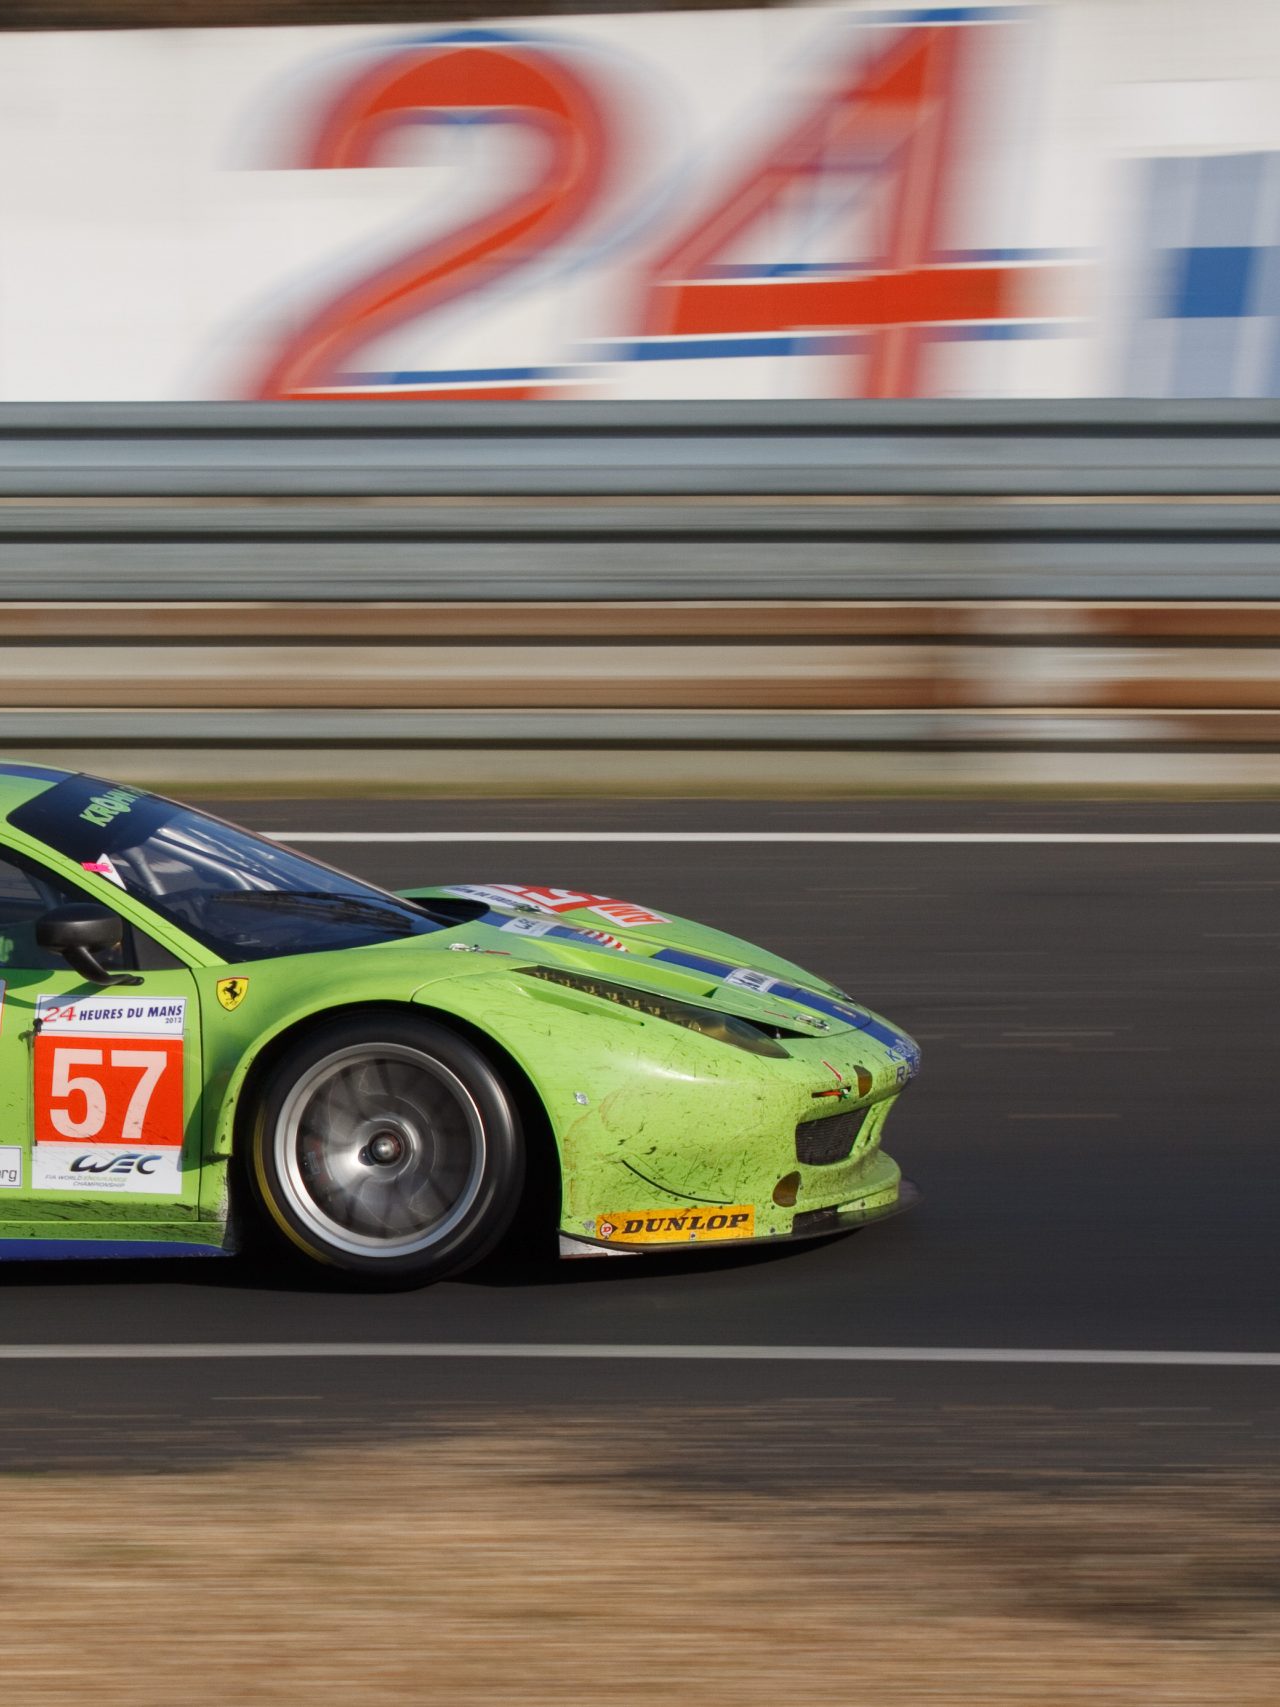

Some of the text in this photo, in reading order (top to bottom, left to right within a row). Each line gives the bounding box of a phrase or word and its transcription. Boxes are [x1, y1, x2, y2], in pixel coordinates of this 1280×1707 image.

[230, 10, 1090, 400] 24
[43, 1005, 183, 1023] 24 HEURES DU MANS
[49, 1047, 168, 1140] 57
[70, 1153, 162, 1175] WEC
[622, 1213, 750, 1235] DUNLOP
